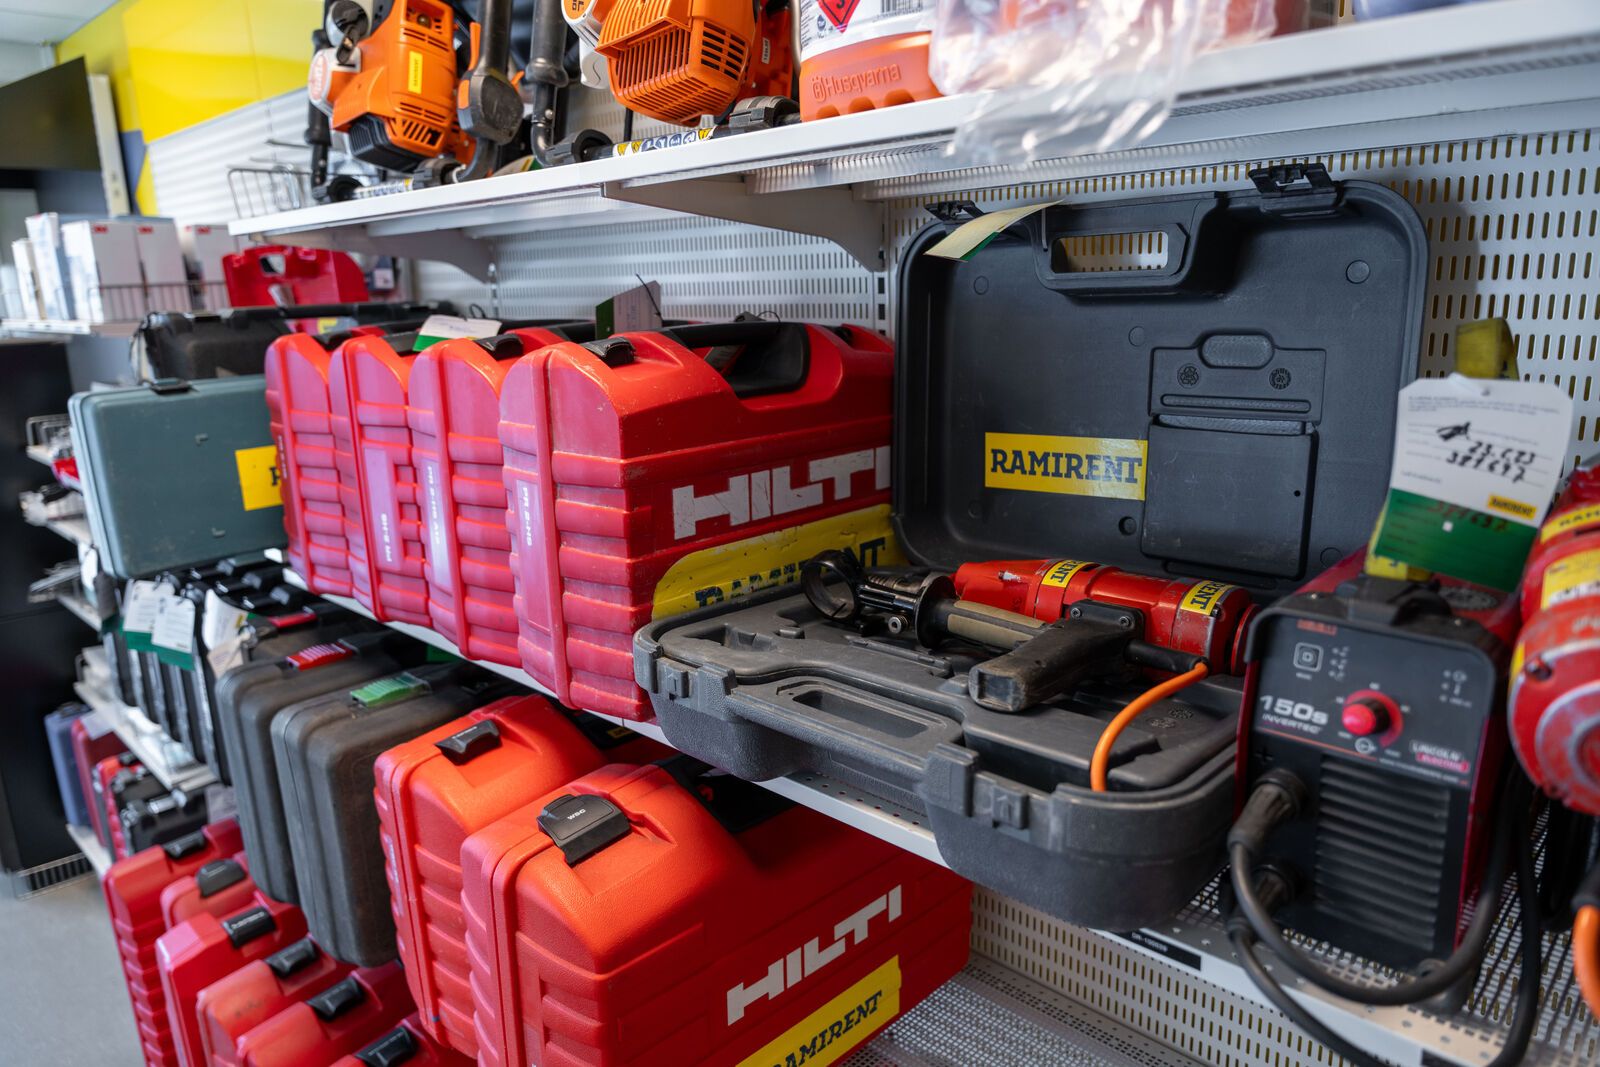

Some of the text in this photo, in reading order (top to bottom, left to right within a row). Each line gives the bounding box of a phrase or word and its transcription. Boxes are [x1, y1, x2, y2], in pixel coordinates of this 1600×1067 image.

[824, 63, 902, 95] Husqvarna
[672, 445, 891, 540] HILTI
[990, 448, 1143, 484] RAMIRENT
[1262, 713, 1321, 735] INVERTEC
[726, 883, 902, 1027] HILTI
[773, 990, 882, 1067] AMIRENT
